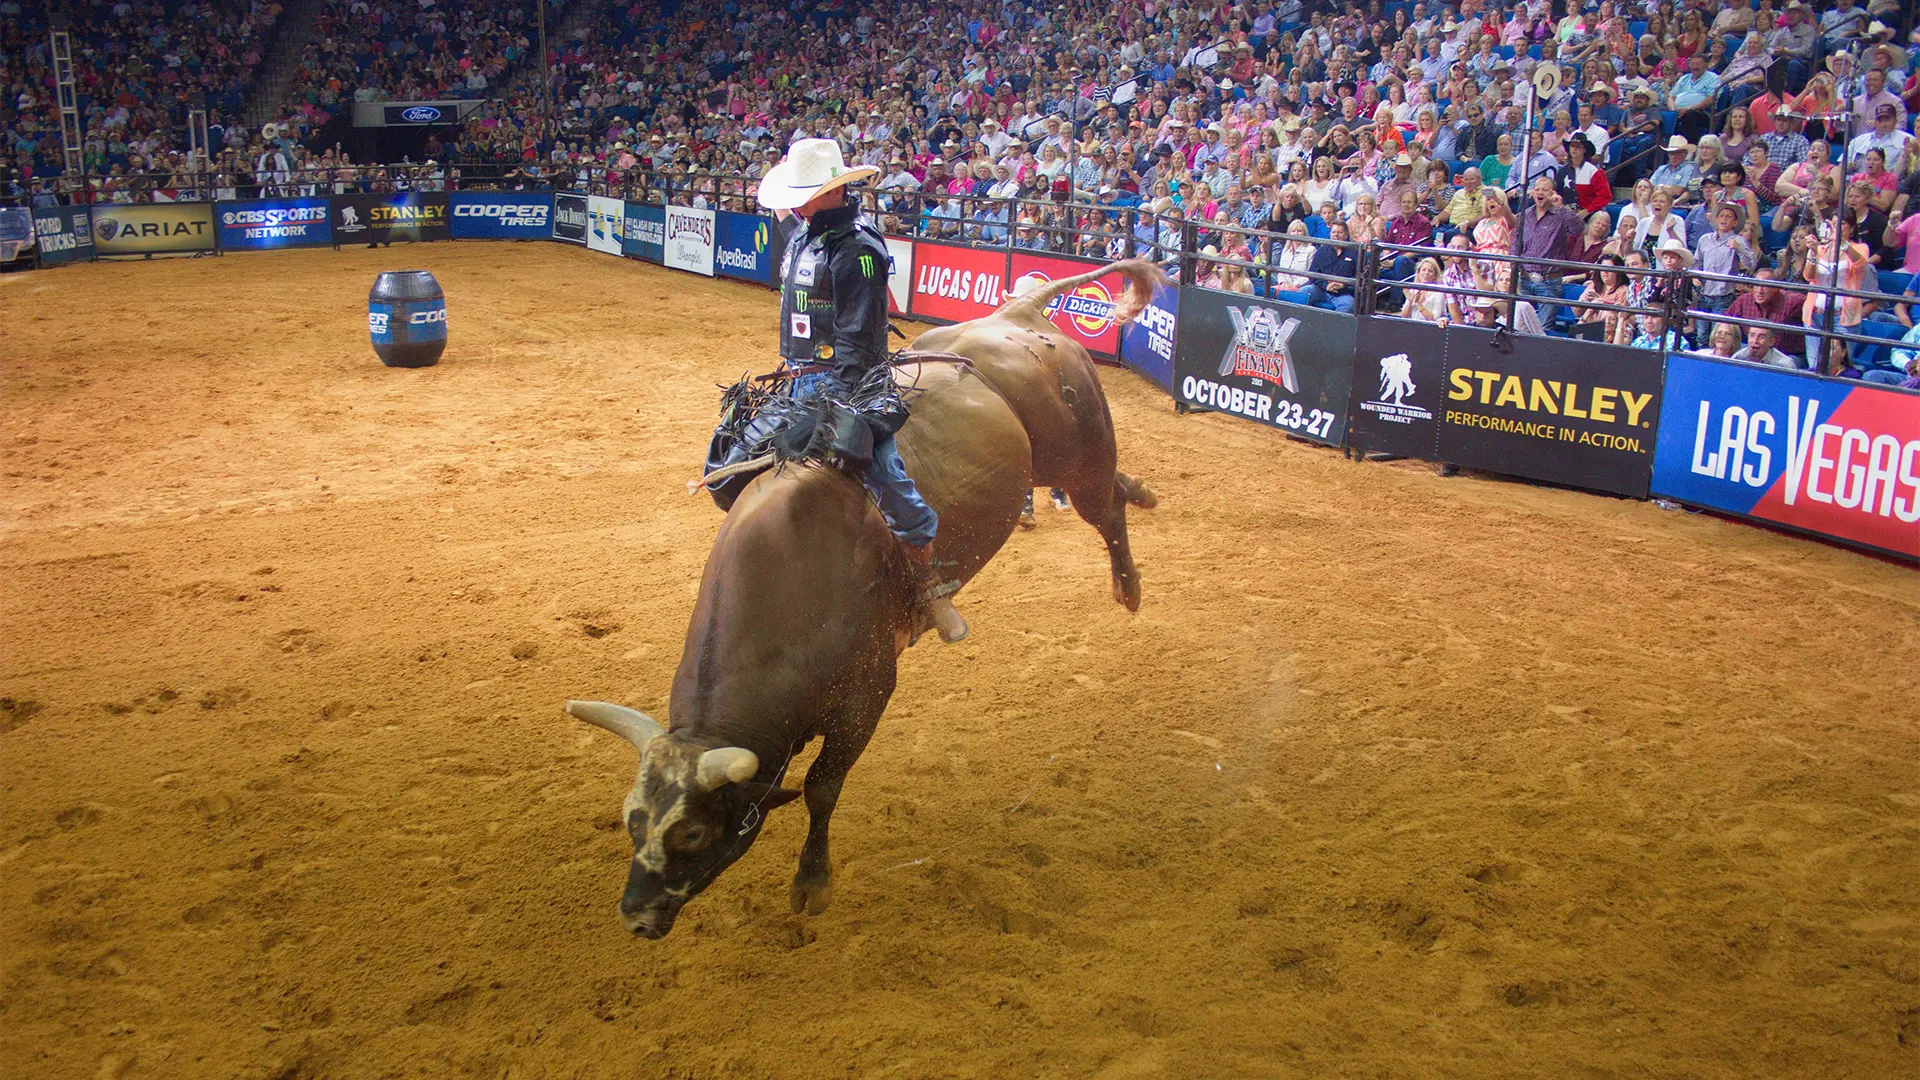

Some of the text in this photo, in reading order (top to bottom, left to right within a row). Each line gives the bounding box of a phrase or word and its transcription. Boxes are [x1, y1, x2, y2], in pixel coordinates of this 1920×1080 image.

[409, 109, 433, 120] Ford
[370, 205, 445, 220] STANLEY
[453, 204, 549, 217] COOPER
[499, 217, 547, 226] TIRES
[35, 216, 62, 235] FORD
[120, 221, 208, 238] ARIAT
[245, 225, 306, 239] NETWORK
[668, 213, 711, 246] CAVENDER'S
[38, 232, 77, 252] TRUCKS
[716, 245, 757, 271] ApexBrasil
[917, 264, 1000, 307] LUCAS OIL
[1133, 303, 1176, 341] OPER
[1148, 330, 1173, 361] TIRES
[1236, 349, 1282, 378] FINALS
[1183, 375, 1335, 439] OCTOBER 23-27
[1448, 368, 1653, 427] STANLEY
[1360, 402, 1433, 420] WOUNDED WARRIOR
[1378, 413, 1412, 424] PROJECT
[1446, 410, 1640, 453] PERFORMANCE IN ACTION
[1691, 395, 1920, 523] LAS VEGAS
